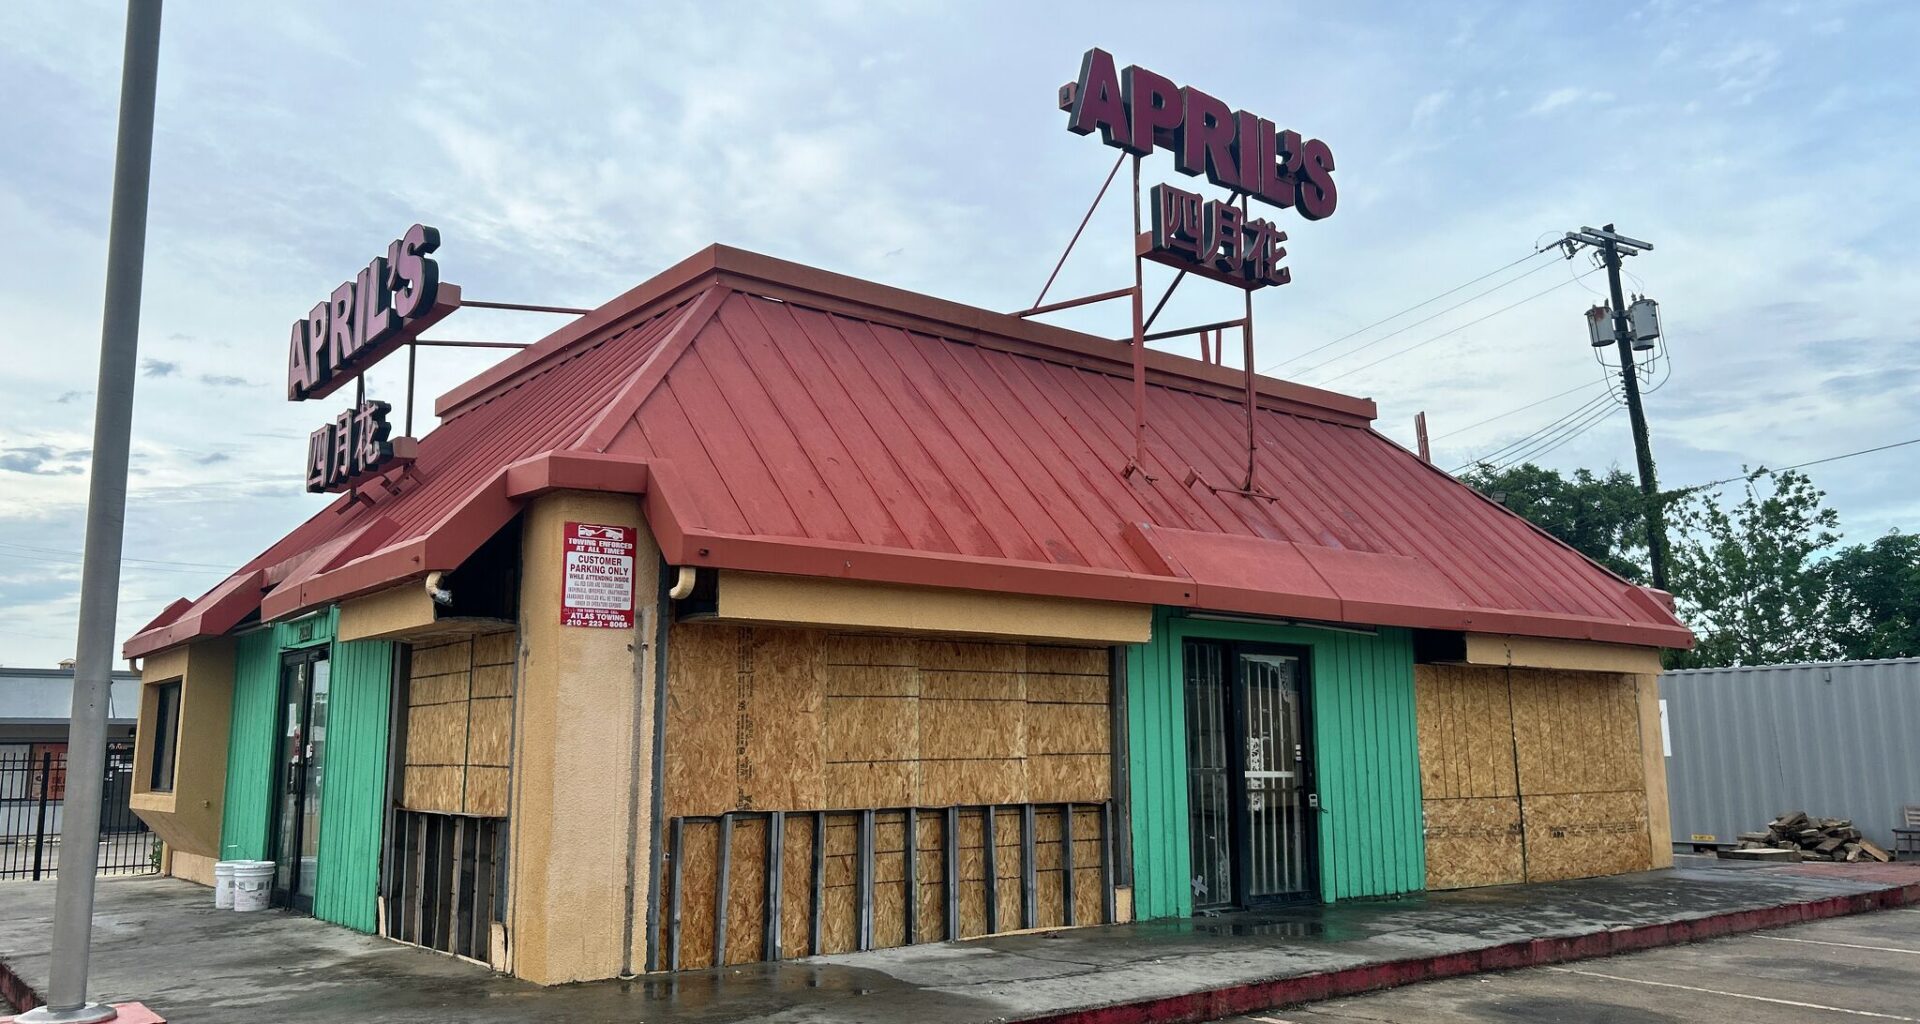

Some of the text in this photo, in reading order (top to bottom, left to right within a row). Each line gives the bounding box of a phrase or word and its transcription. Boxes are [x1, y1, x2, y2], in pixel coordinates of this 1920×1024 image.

[1067, 47, 1338, 221] APRIL'S
[1150, 183, 1291, 286] 四月花
[288, 223, 439, 401] APRIL'S
[306, 399, 391, 492] 四月花
[568, 538, 633, 549] TOWING ENFORCED
[578, 555, 622, 566] CUSTOMER
[570, 564, 629, 576] PARKING ONLY
[586, 574, 613, 582] ATTENDING
